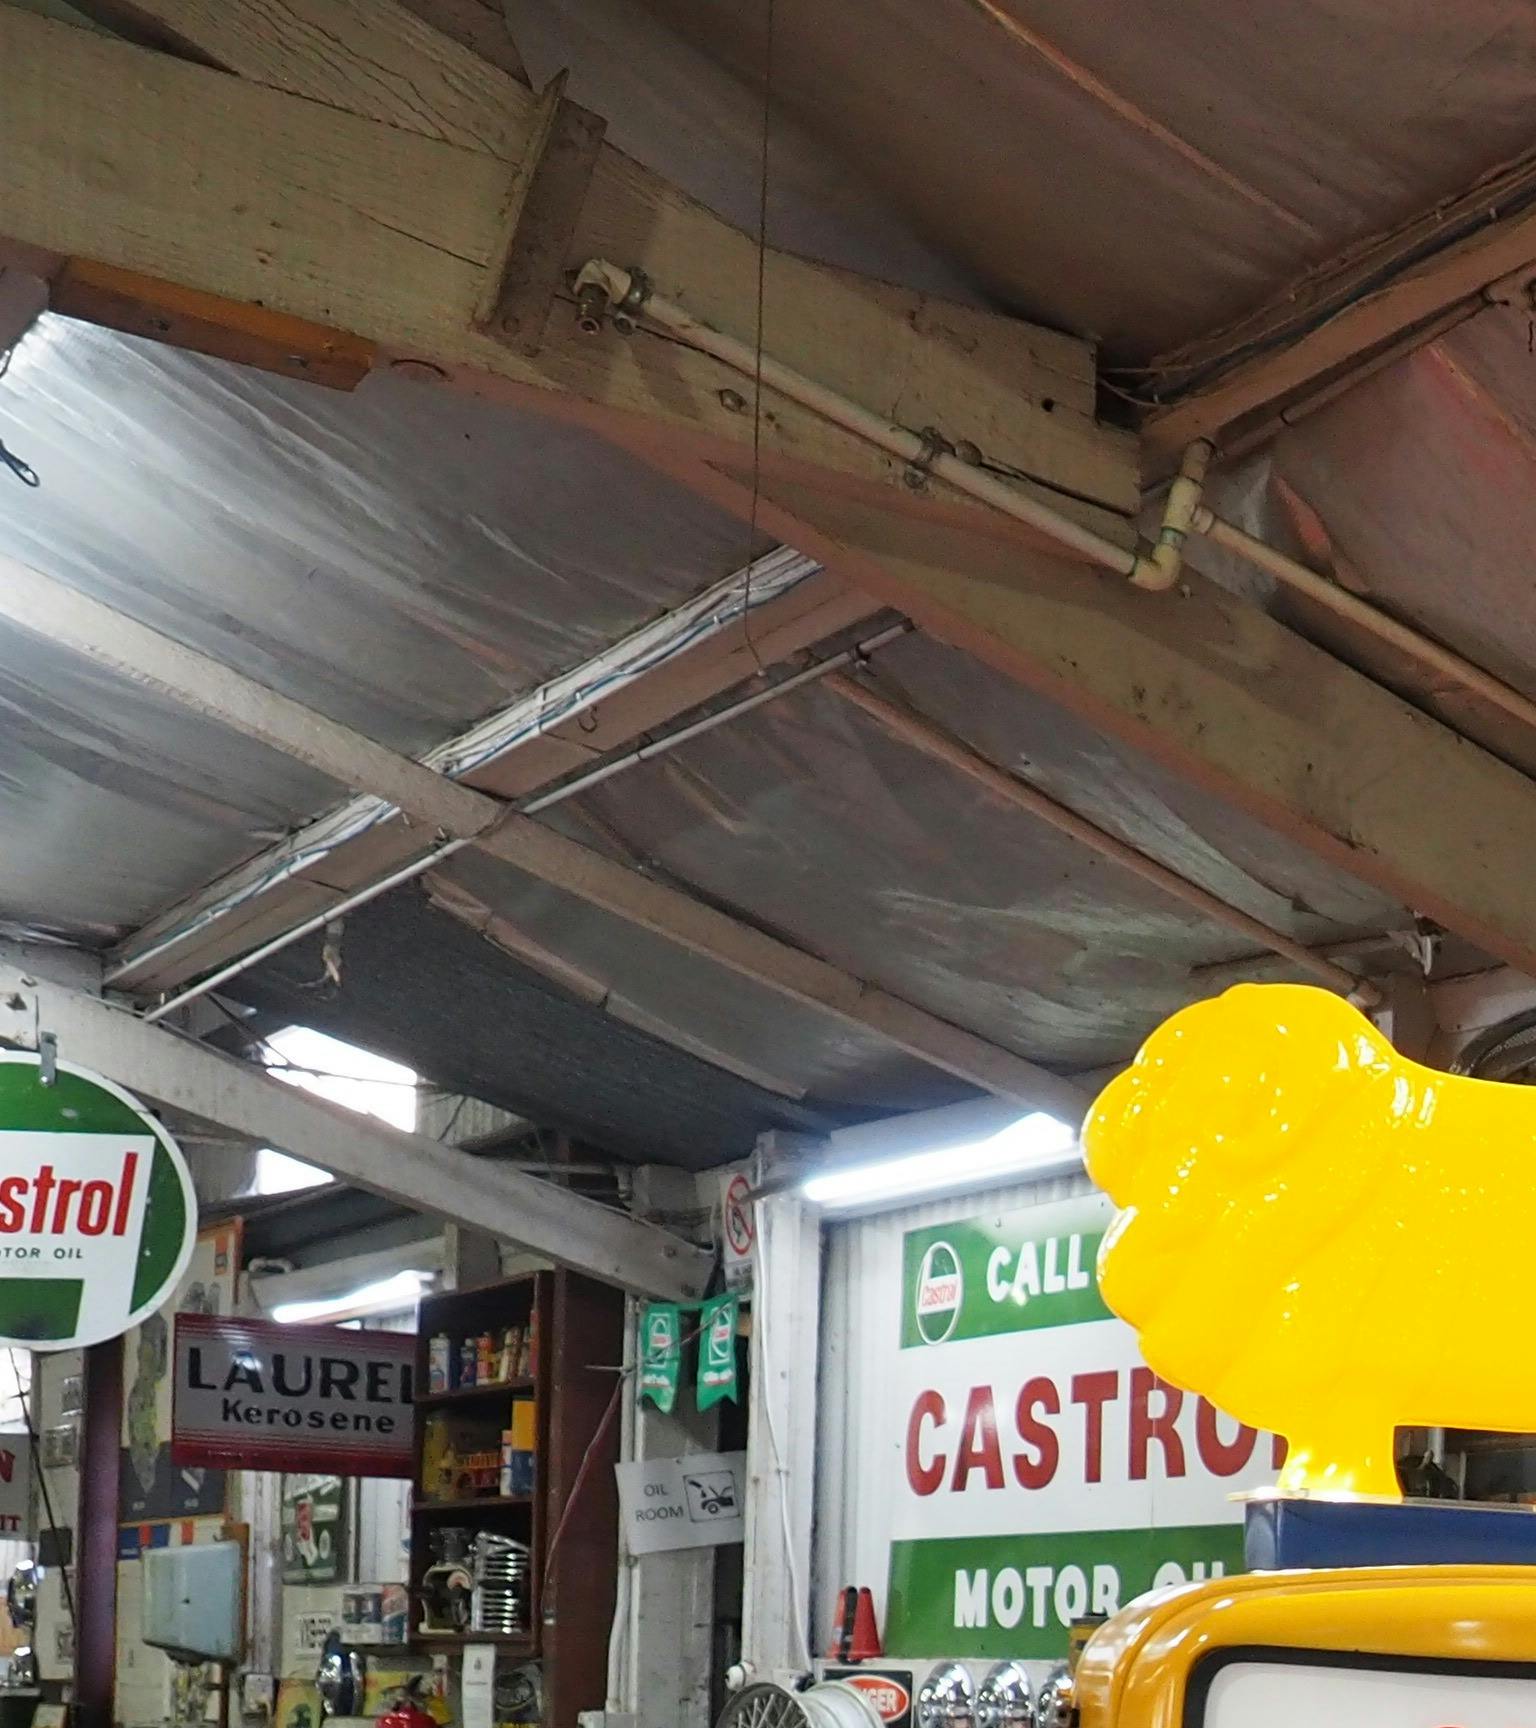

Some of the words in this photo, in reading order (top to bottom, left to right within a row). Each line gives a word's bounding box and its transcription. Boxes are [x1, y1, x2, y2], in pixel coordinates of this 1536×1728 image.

[0, 1247, 40, 1259] TOR
[53, 1247, 84, 1259] OIL
[986, 1233, 1089, 1303] CALL
[222, 1398, 395, 1434] Kerosene
[906, 1366, 1288, 1496] CASTRO
[643, 1483, 668, 1497] OIL
[636, 1505, 684, 1522] ROOM
[954, 1564, 1120, 1629] MOTOR
